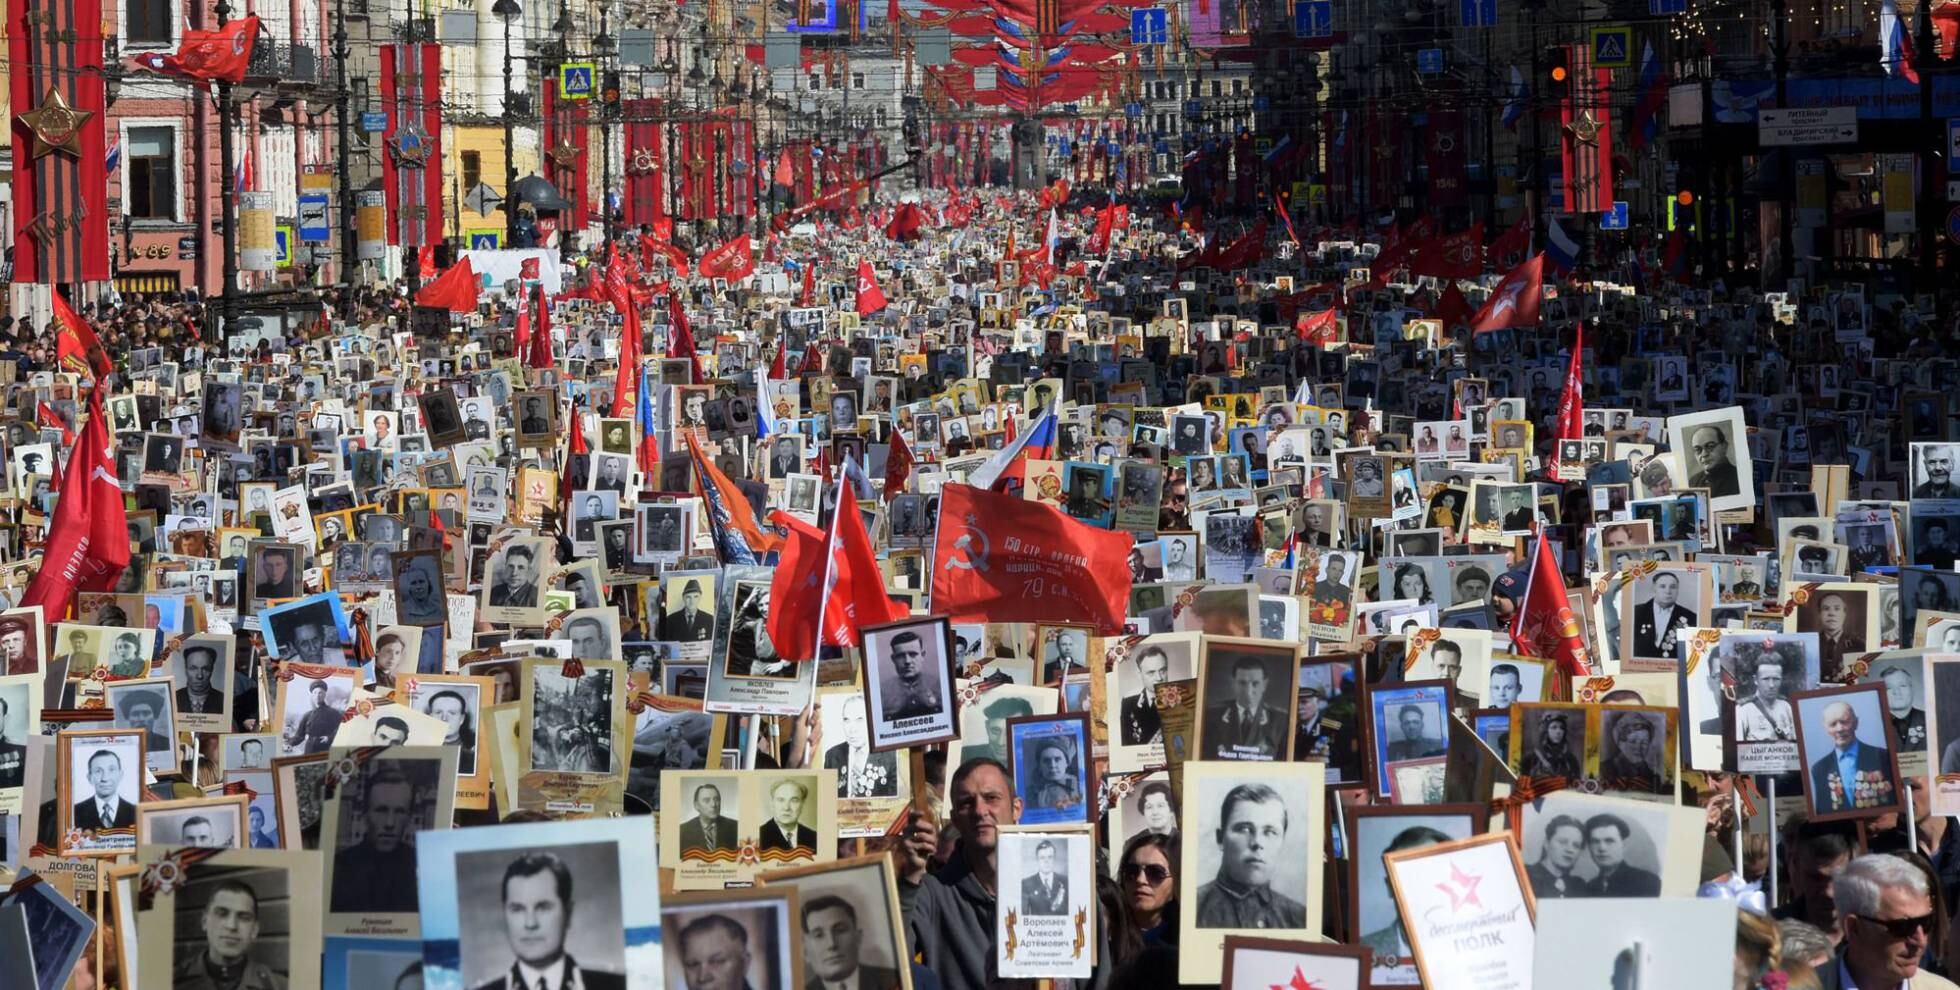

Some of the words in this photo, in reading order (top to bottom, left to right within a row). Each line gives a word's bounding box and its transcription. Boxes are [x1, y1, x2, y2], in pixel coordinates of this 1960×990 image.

[1787, 110, 1828, 119] ЛИТЕЙНЫЙ
[1003, 535, 1021, 553] 150
[1021, 576, 1044, 599] 79
[892, 716, 935, 730] Алексеев
[1751, 746, 1794, 755] ЦЫГАНКОВ
[48, 861, 96, 873] ДОЛГОВА
[1023, 917, 1068, 929] Воропаев
[1027, 928, 1064, 938] Алексей
[1020, 938, 1070, 949] Артёмович
[1454, 930, 1504, 953] ПОЛК
